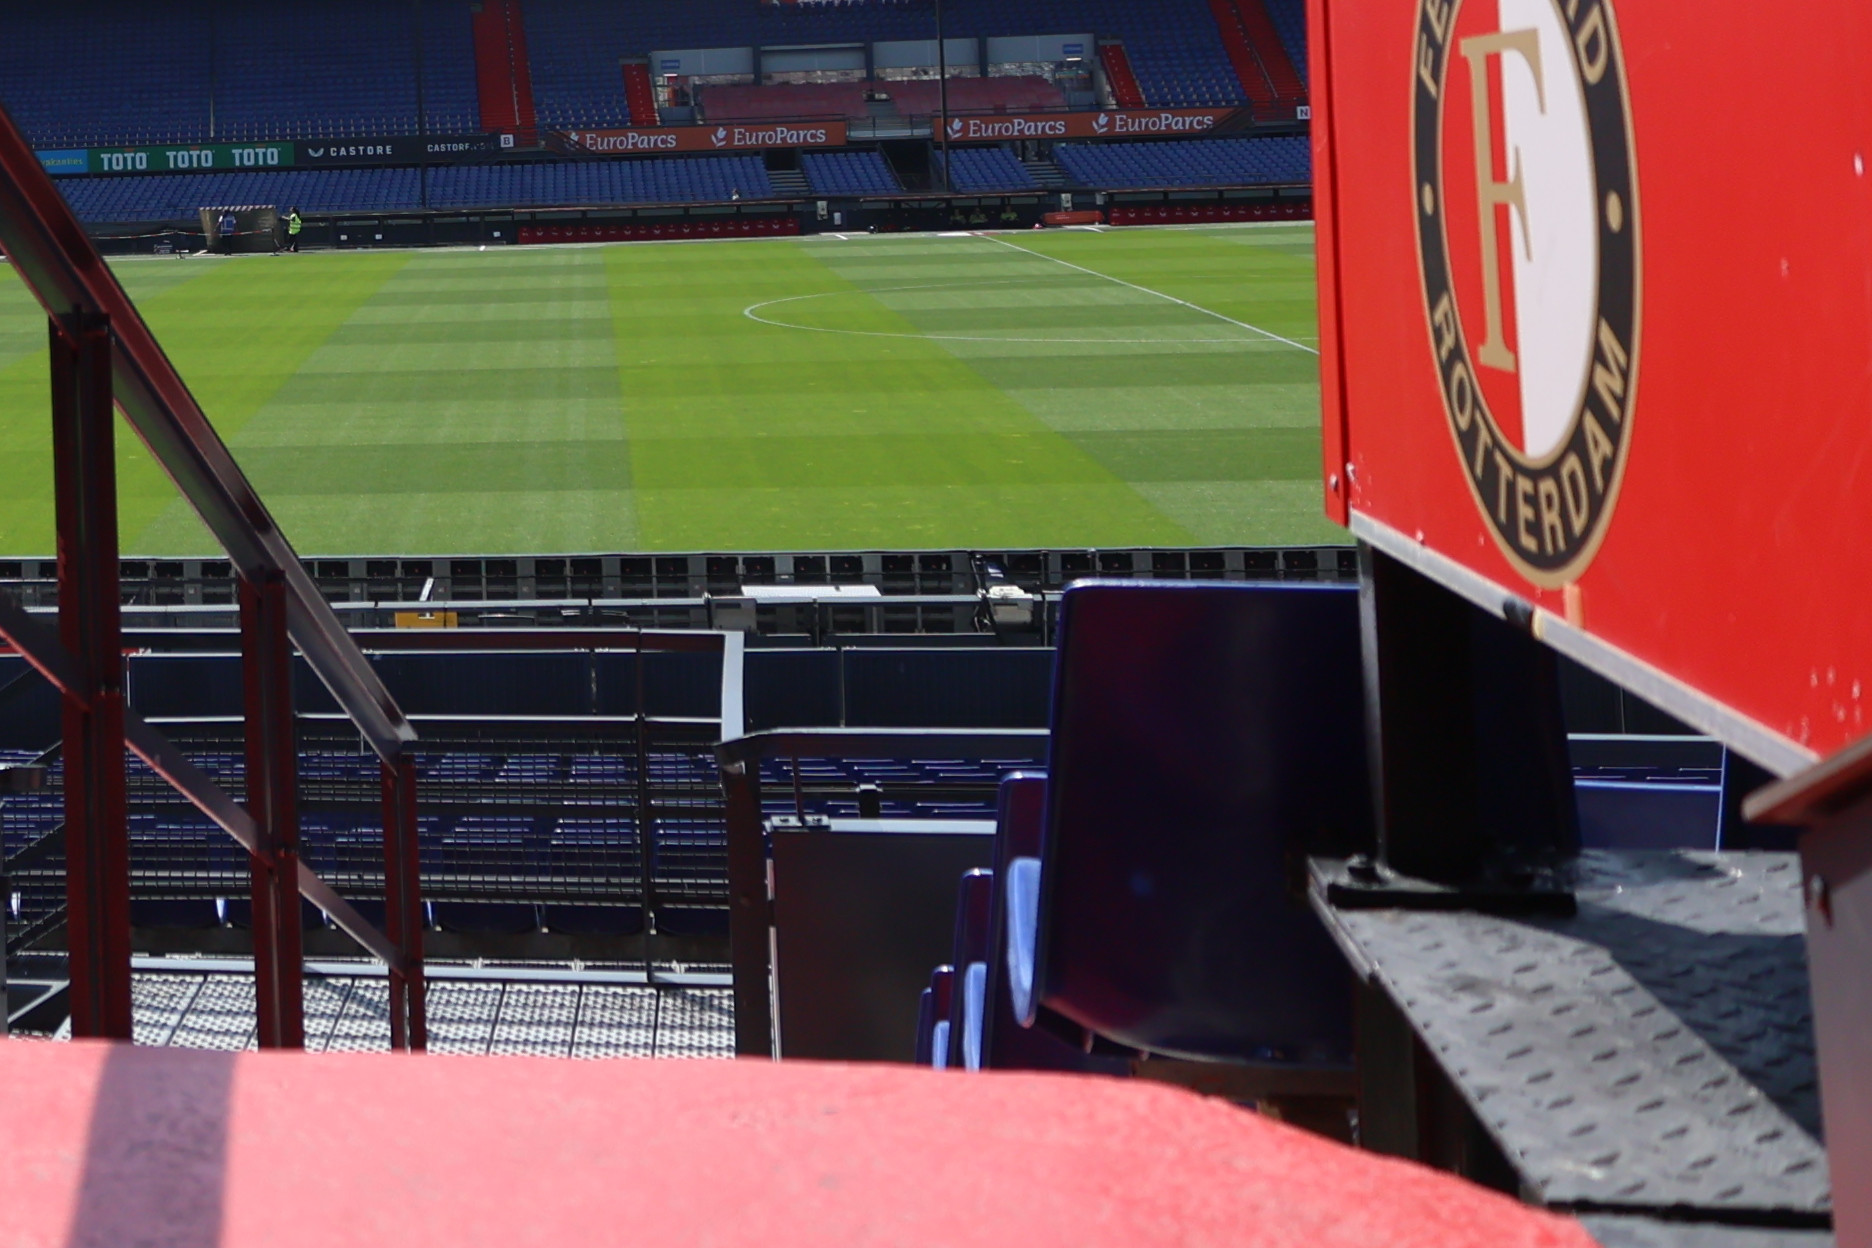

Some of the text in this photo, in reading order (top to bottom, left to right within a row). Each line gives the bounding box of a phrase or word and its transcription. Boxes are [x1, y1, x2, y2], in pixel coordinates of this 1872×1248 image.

[968, 118, 1066, 137] EuroParcs
[1115, 114, 1214, 133] EuroParcs
[585, 131, 677, 151] EuroParcs
[733, 126, 826, 146] EuroParcs
[166, 150, 214, 169] TOTO
[231, 147, 280, 167] TOTO
[330, 145, 393, 157] CASTORE
[100, 152, 148, 171] TOTO
[1459, 26, 1547, 375] F
[1432, 289, 1630, 557] ROTTERDAM
